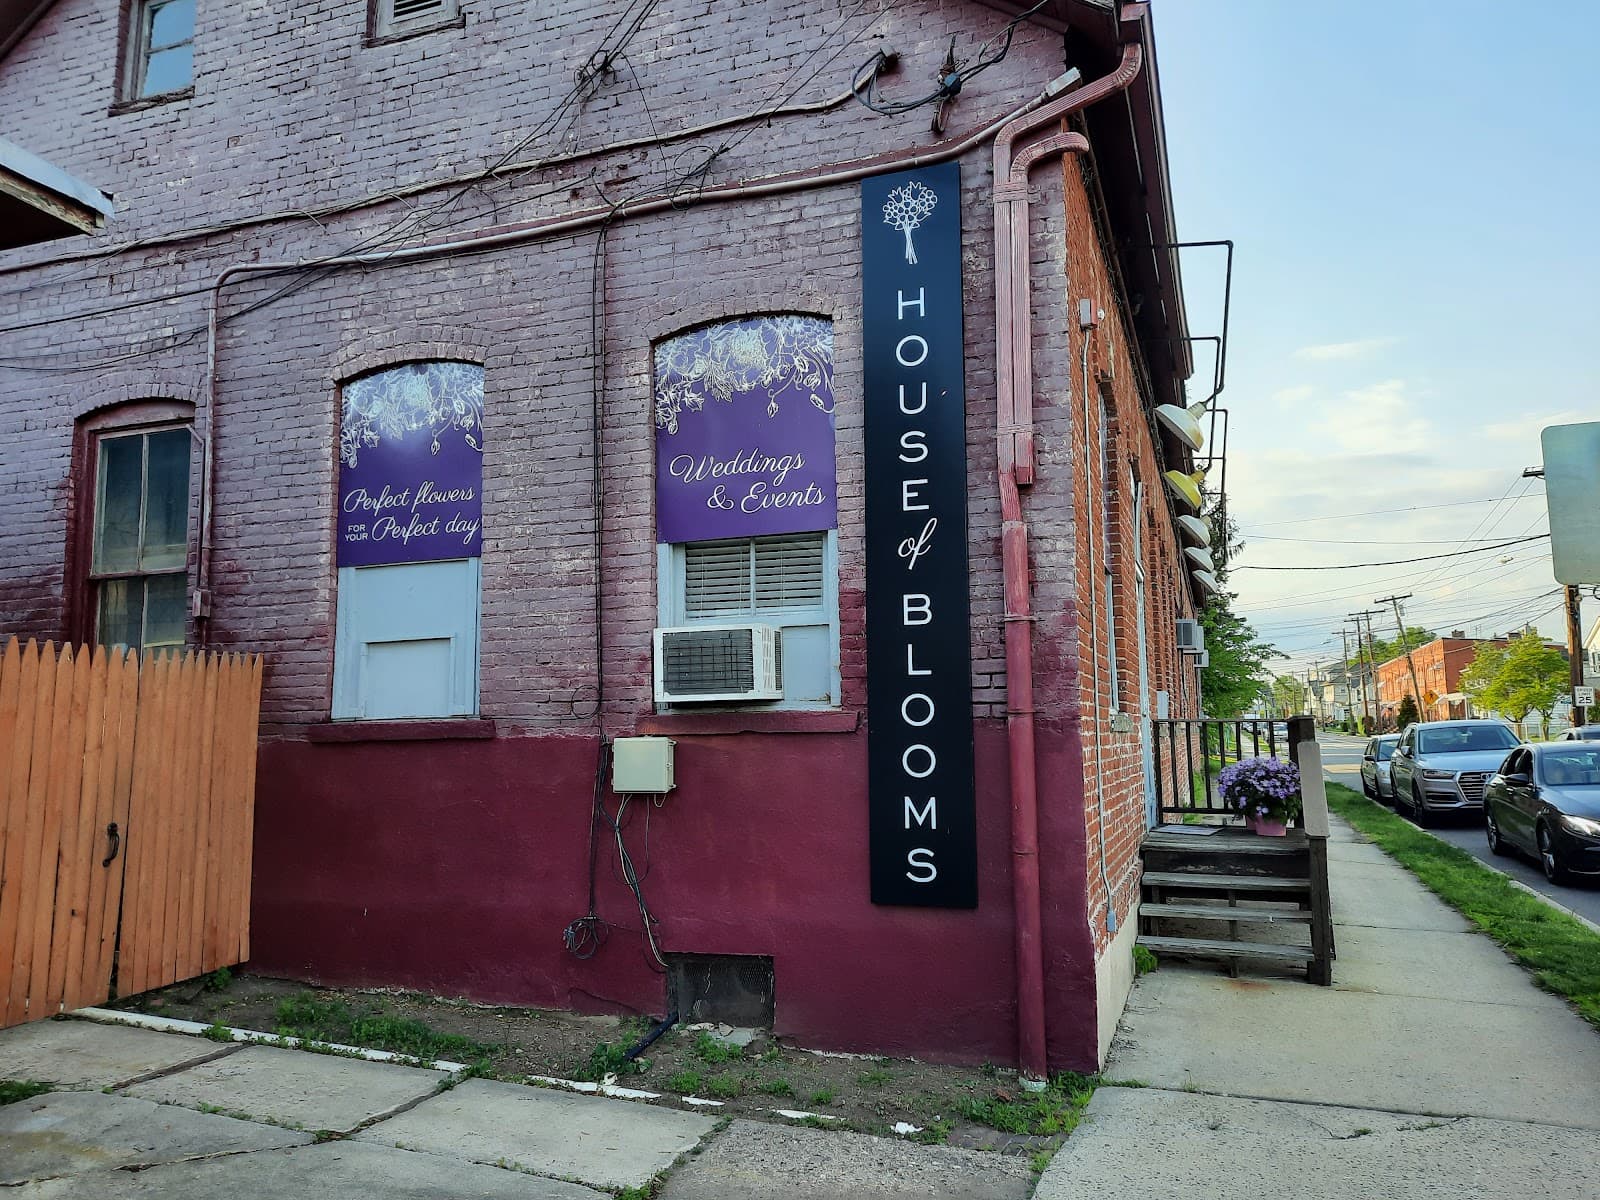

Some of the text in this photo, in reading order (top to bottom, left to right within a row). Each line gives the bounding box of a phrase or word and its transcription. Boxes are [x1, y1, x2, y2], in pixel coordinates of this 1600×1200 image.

[669, 448, 805, 487] Weddings
[343, 480, 475, 516] Perfect flowers
[707, 481, 826, 514] & Events
[344, 533, 368, 542] YOUR
[347, 524, 366, 533] FOR
[371, 512, 480, 545] Perfect day
[895, 287, 938, 884] HOUSE of BLOOMS
[1578, 696, 1592, 704] 25
